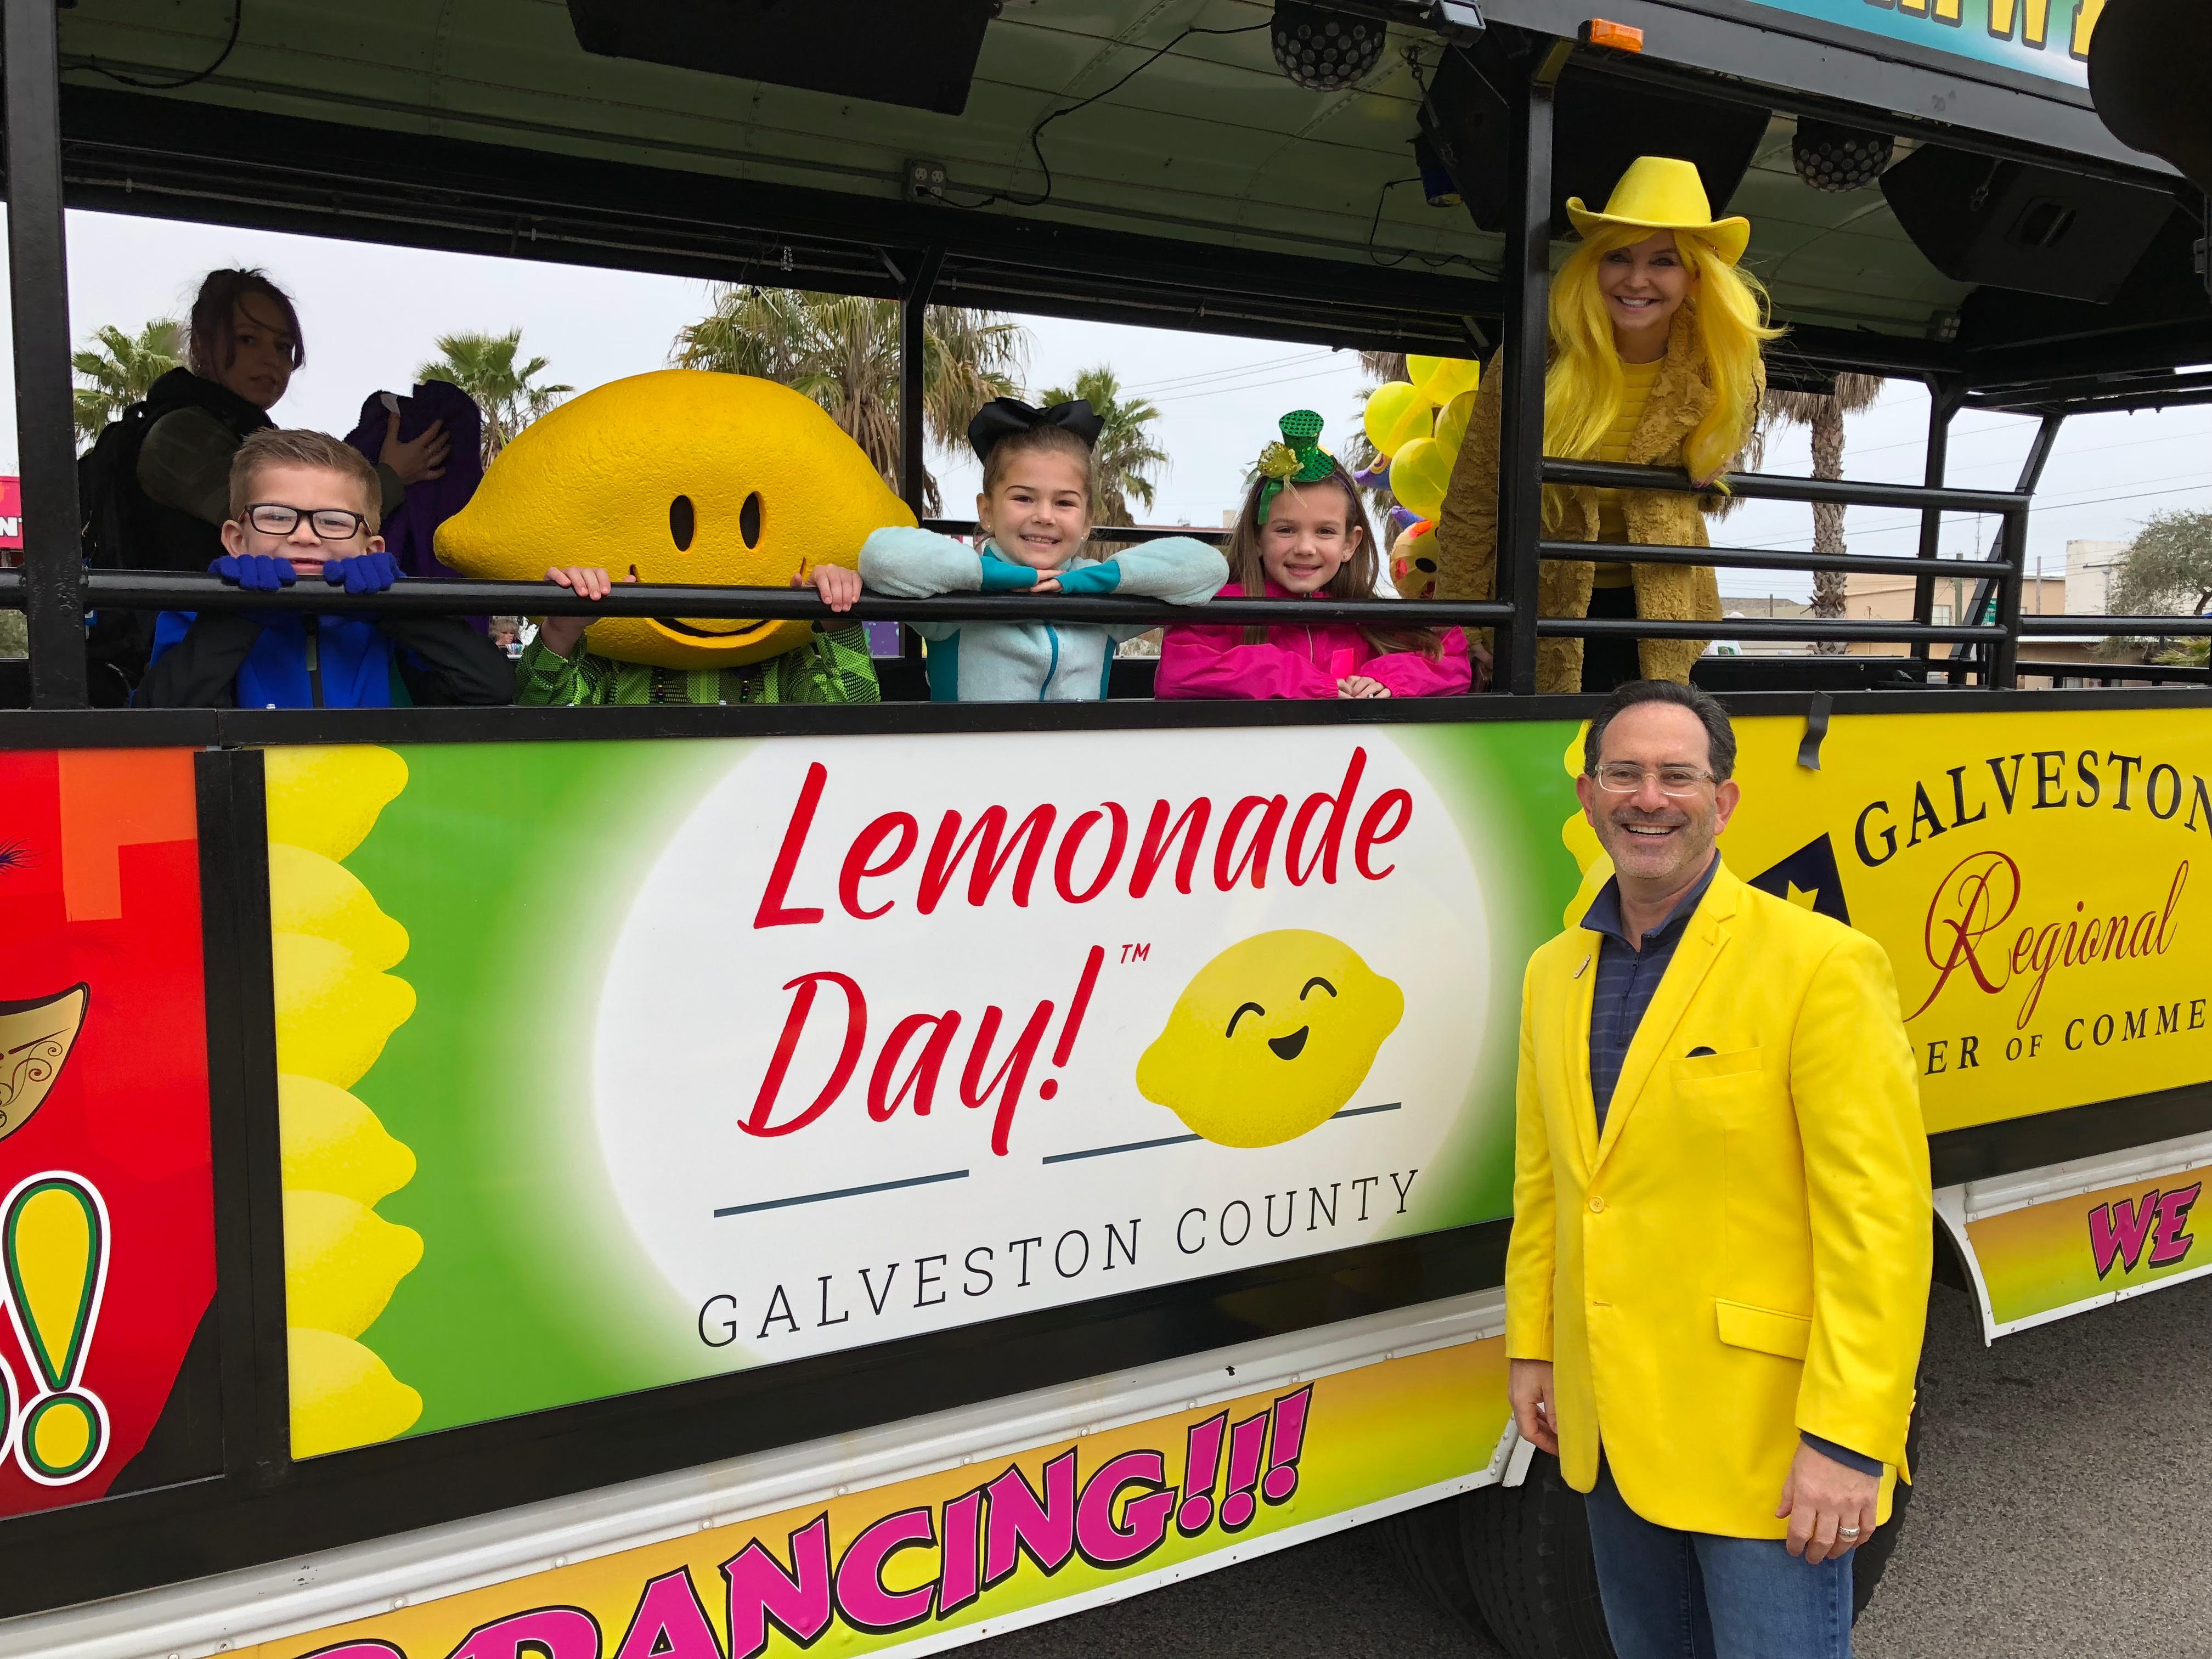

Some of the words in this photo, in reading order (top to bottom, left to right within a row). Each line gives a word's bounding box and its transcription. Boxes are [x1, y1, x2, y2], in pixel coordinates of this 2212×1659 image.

[753, 746, 1414, 930] Lemonade
[1903, 850, 2190, 1030] Regional
[736, 944, 1106, 1157] Day!
[1120, 943, 1151, 964] TM
[1910, 1035, 1980, 1076] ER
[2005, 1034, 2043, 1062] OF
[2064, 998, 2207, 1051] COMME
[697, 1218, 1143, 1348] GALVESTON
[1177, 1168, 1419, 1255] COUNTY
[2087, 1181, 2202, 1282] WE
